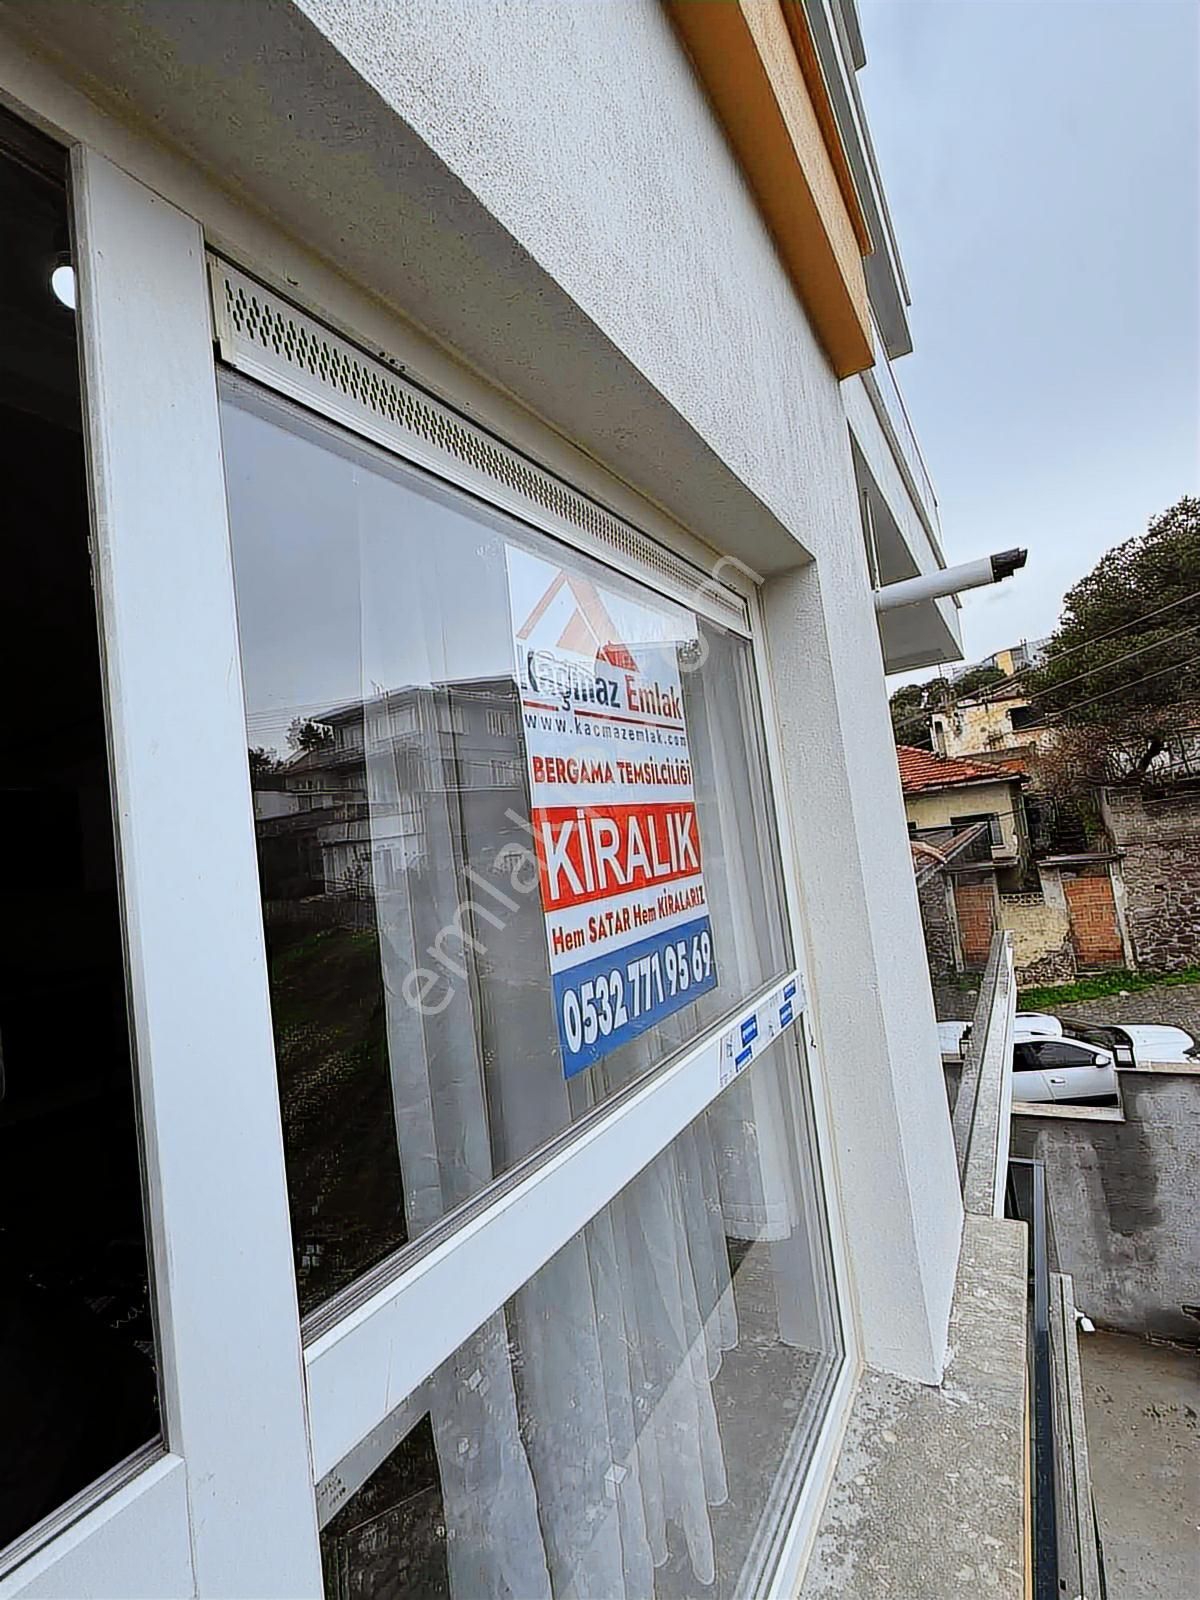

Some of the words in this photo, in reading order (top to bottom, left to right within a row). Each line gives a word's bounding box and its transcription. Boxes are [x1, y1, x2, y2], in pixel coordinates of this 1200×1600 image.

[625, 674, 683, 720] Emlak
[525, 712, 687, 747] www.kacmazemlak.com
[533, 756, 614, 785] BERGAMA
[616, 755, 692, 785] TEMSİLCİLİĞİ
[541, 808, 699, 901] KİRALIK
[552, 925, 585, 956] Hem
[588, 907, 632, 944] SATAR
[633, 903, 656, 928] Hem
[657, 885, 706, 919] KİRALARIZ
[563, 967, 629, 1054] 0532
[626, 951, 665, 1018] 771
[665, 940, 690, 998] 95
[691, 930, 712, 984] 69
